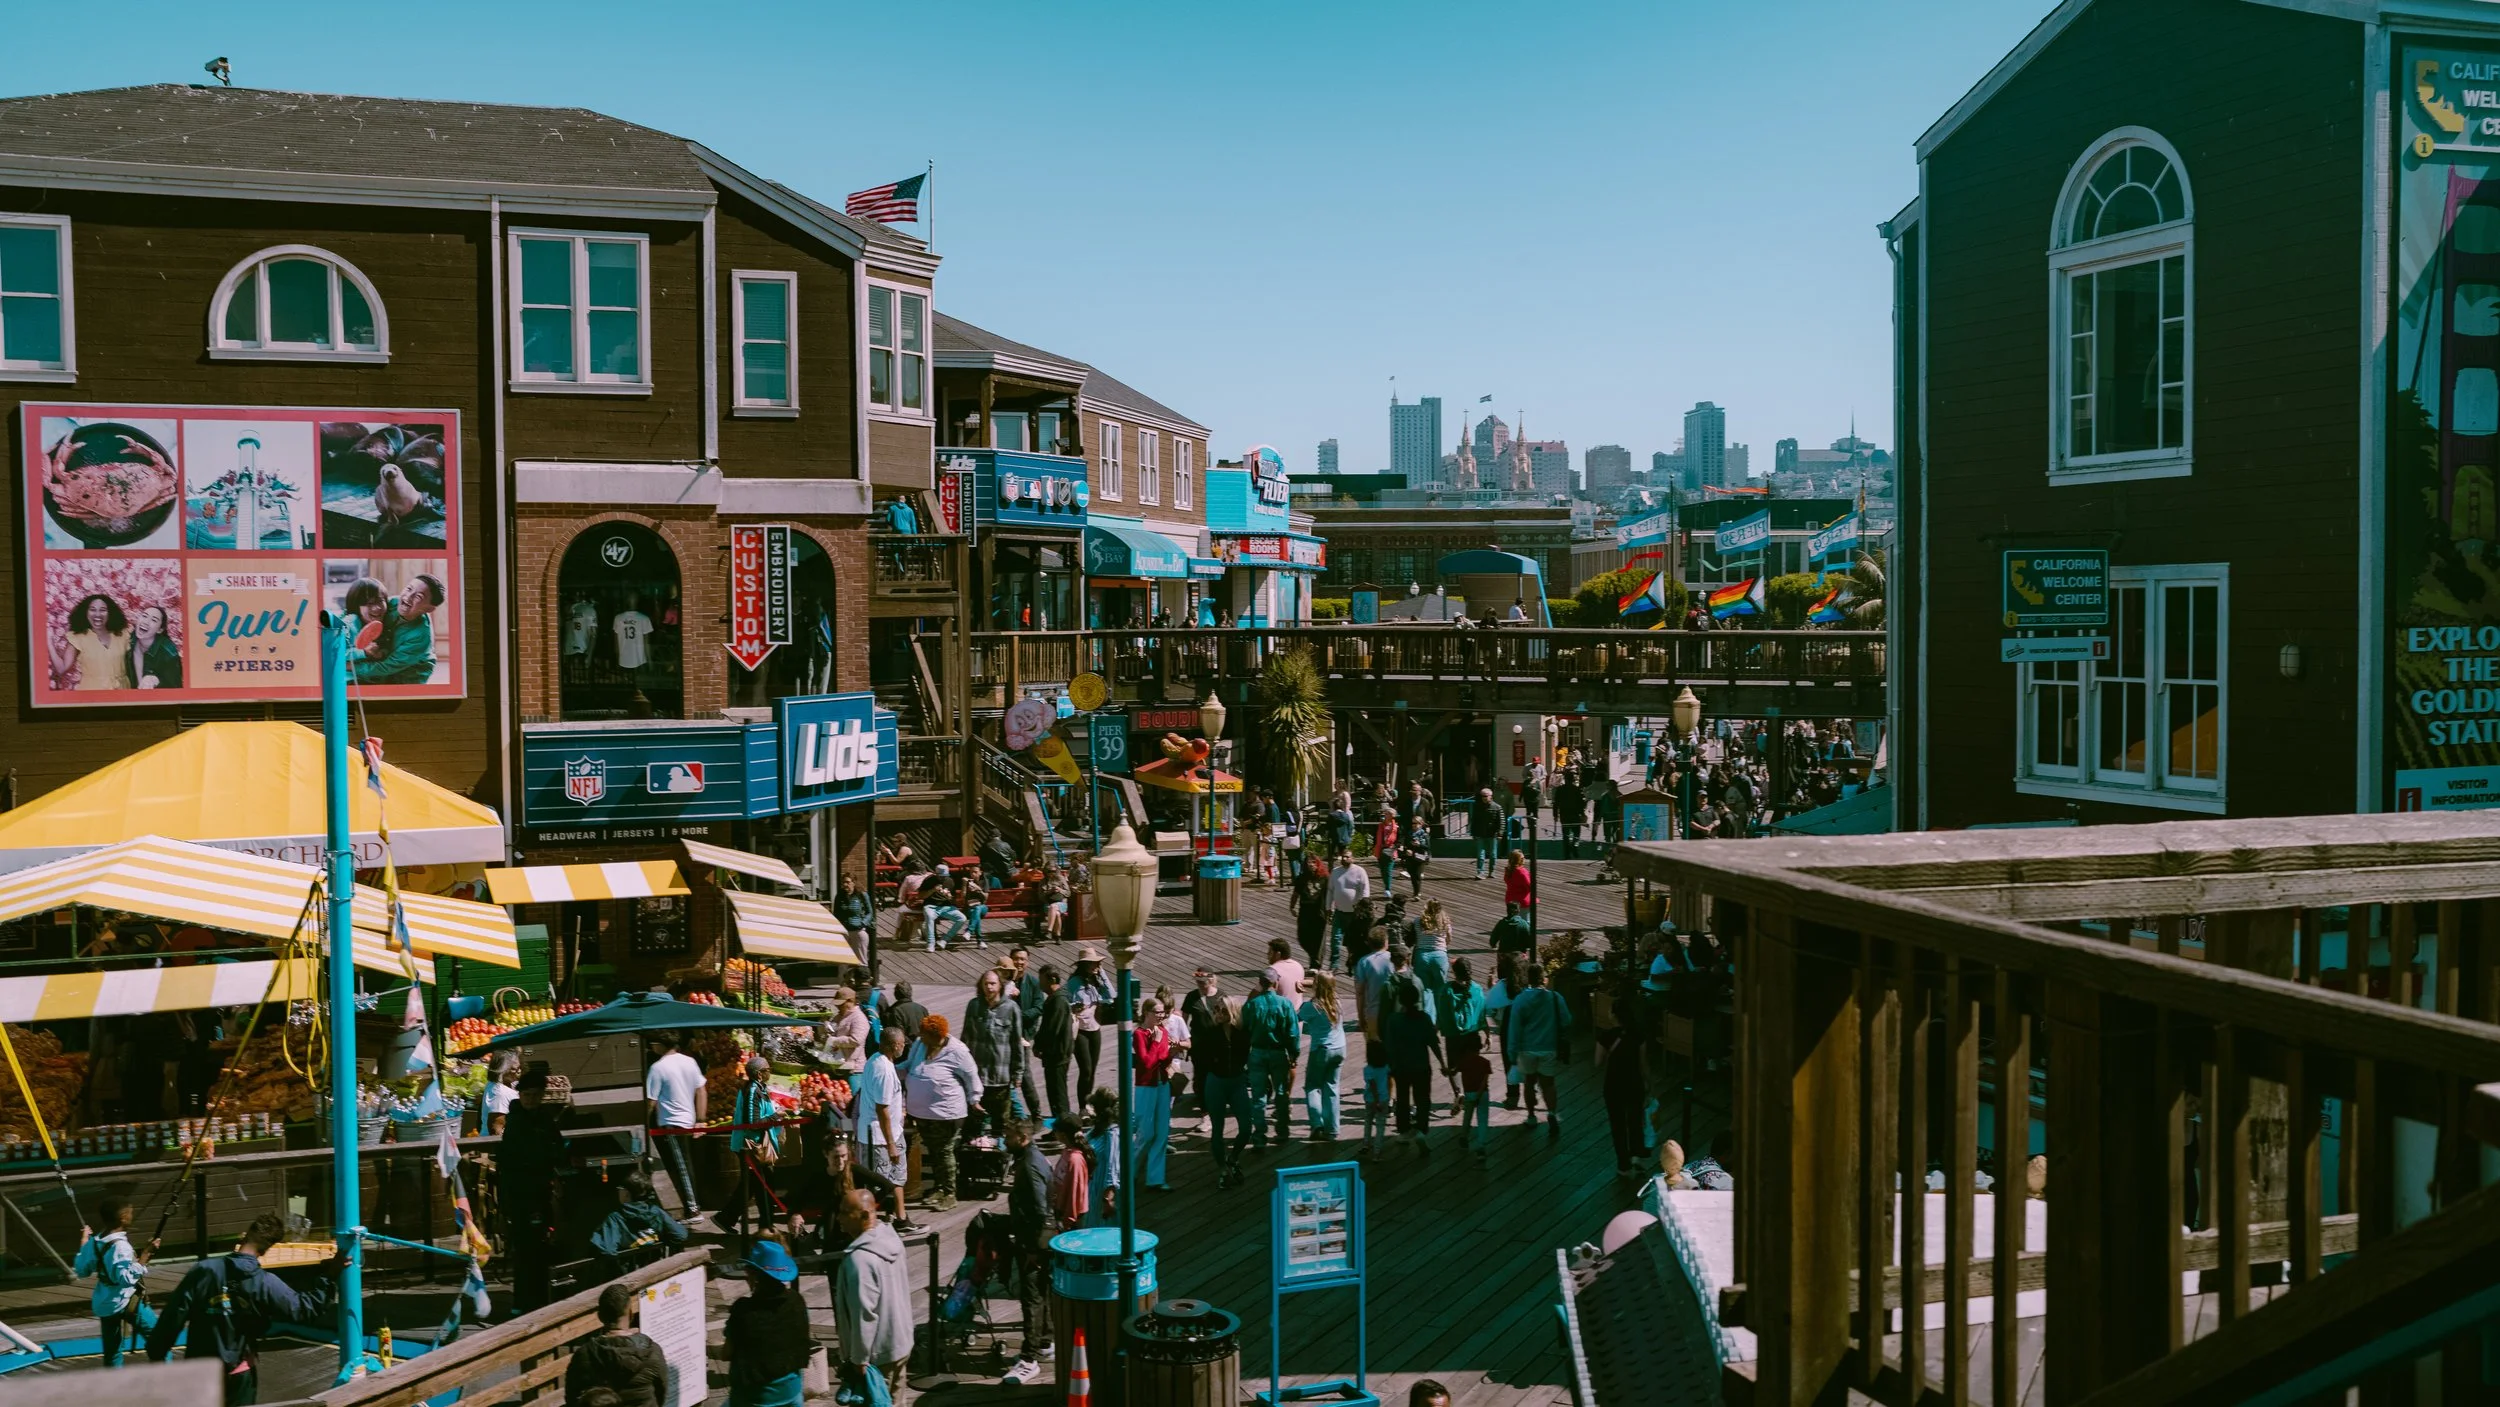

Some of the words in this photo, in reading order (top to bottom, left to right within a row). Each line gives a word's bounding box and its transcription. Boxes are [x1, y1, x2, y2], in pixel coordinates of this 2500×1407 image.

[946, 475, 955, 535] CUST
[1249, 537, 1280, 545] ESCAPE
[1249, 545, 1280, 553] ROOMS
[1104, 553, 1125, 564] BAY
[2033, 559, 2102, 570] CALIFORNIA
[226, 576, 257, 587] SHARE
[261, 576, 278, 587] THE
[770, 532, 785, 637] EMBROIDERY
[2043, 576, 2102, 588] WELCOME
[741, 530, 760, 657] CUSTOM
[2055, 594, 2102, 605] CENTER
[198, 599, 308, 648] Fun!
[624, 626, 636, 640] 13
[2408, 626, 2500, 652] EXPLO
[214, 660, 295, 672] #PIER39
[2443, 657, 2500, 681] THE
[1138, 711, 1198, 728] BOUDI
[1098, 725, 1123, 736] PIER
[2428, 719, 2500, 746] STAT
[794, 719, 879, 786] Lids
[1098, 737, 1125, 760] 39
[571, 777, 600, 798] NFL
[2448, 779, 2488, 790] VISITOR
[539, 831, 596, 841] HEADWEAR
[612, 829, 654, 838] JERSEYS
[682, 826, 708, 835] MORE
[243, 842, 383, 864] RCHRD
